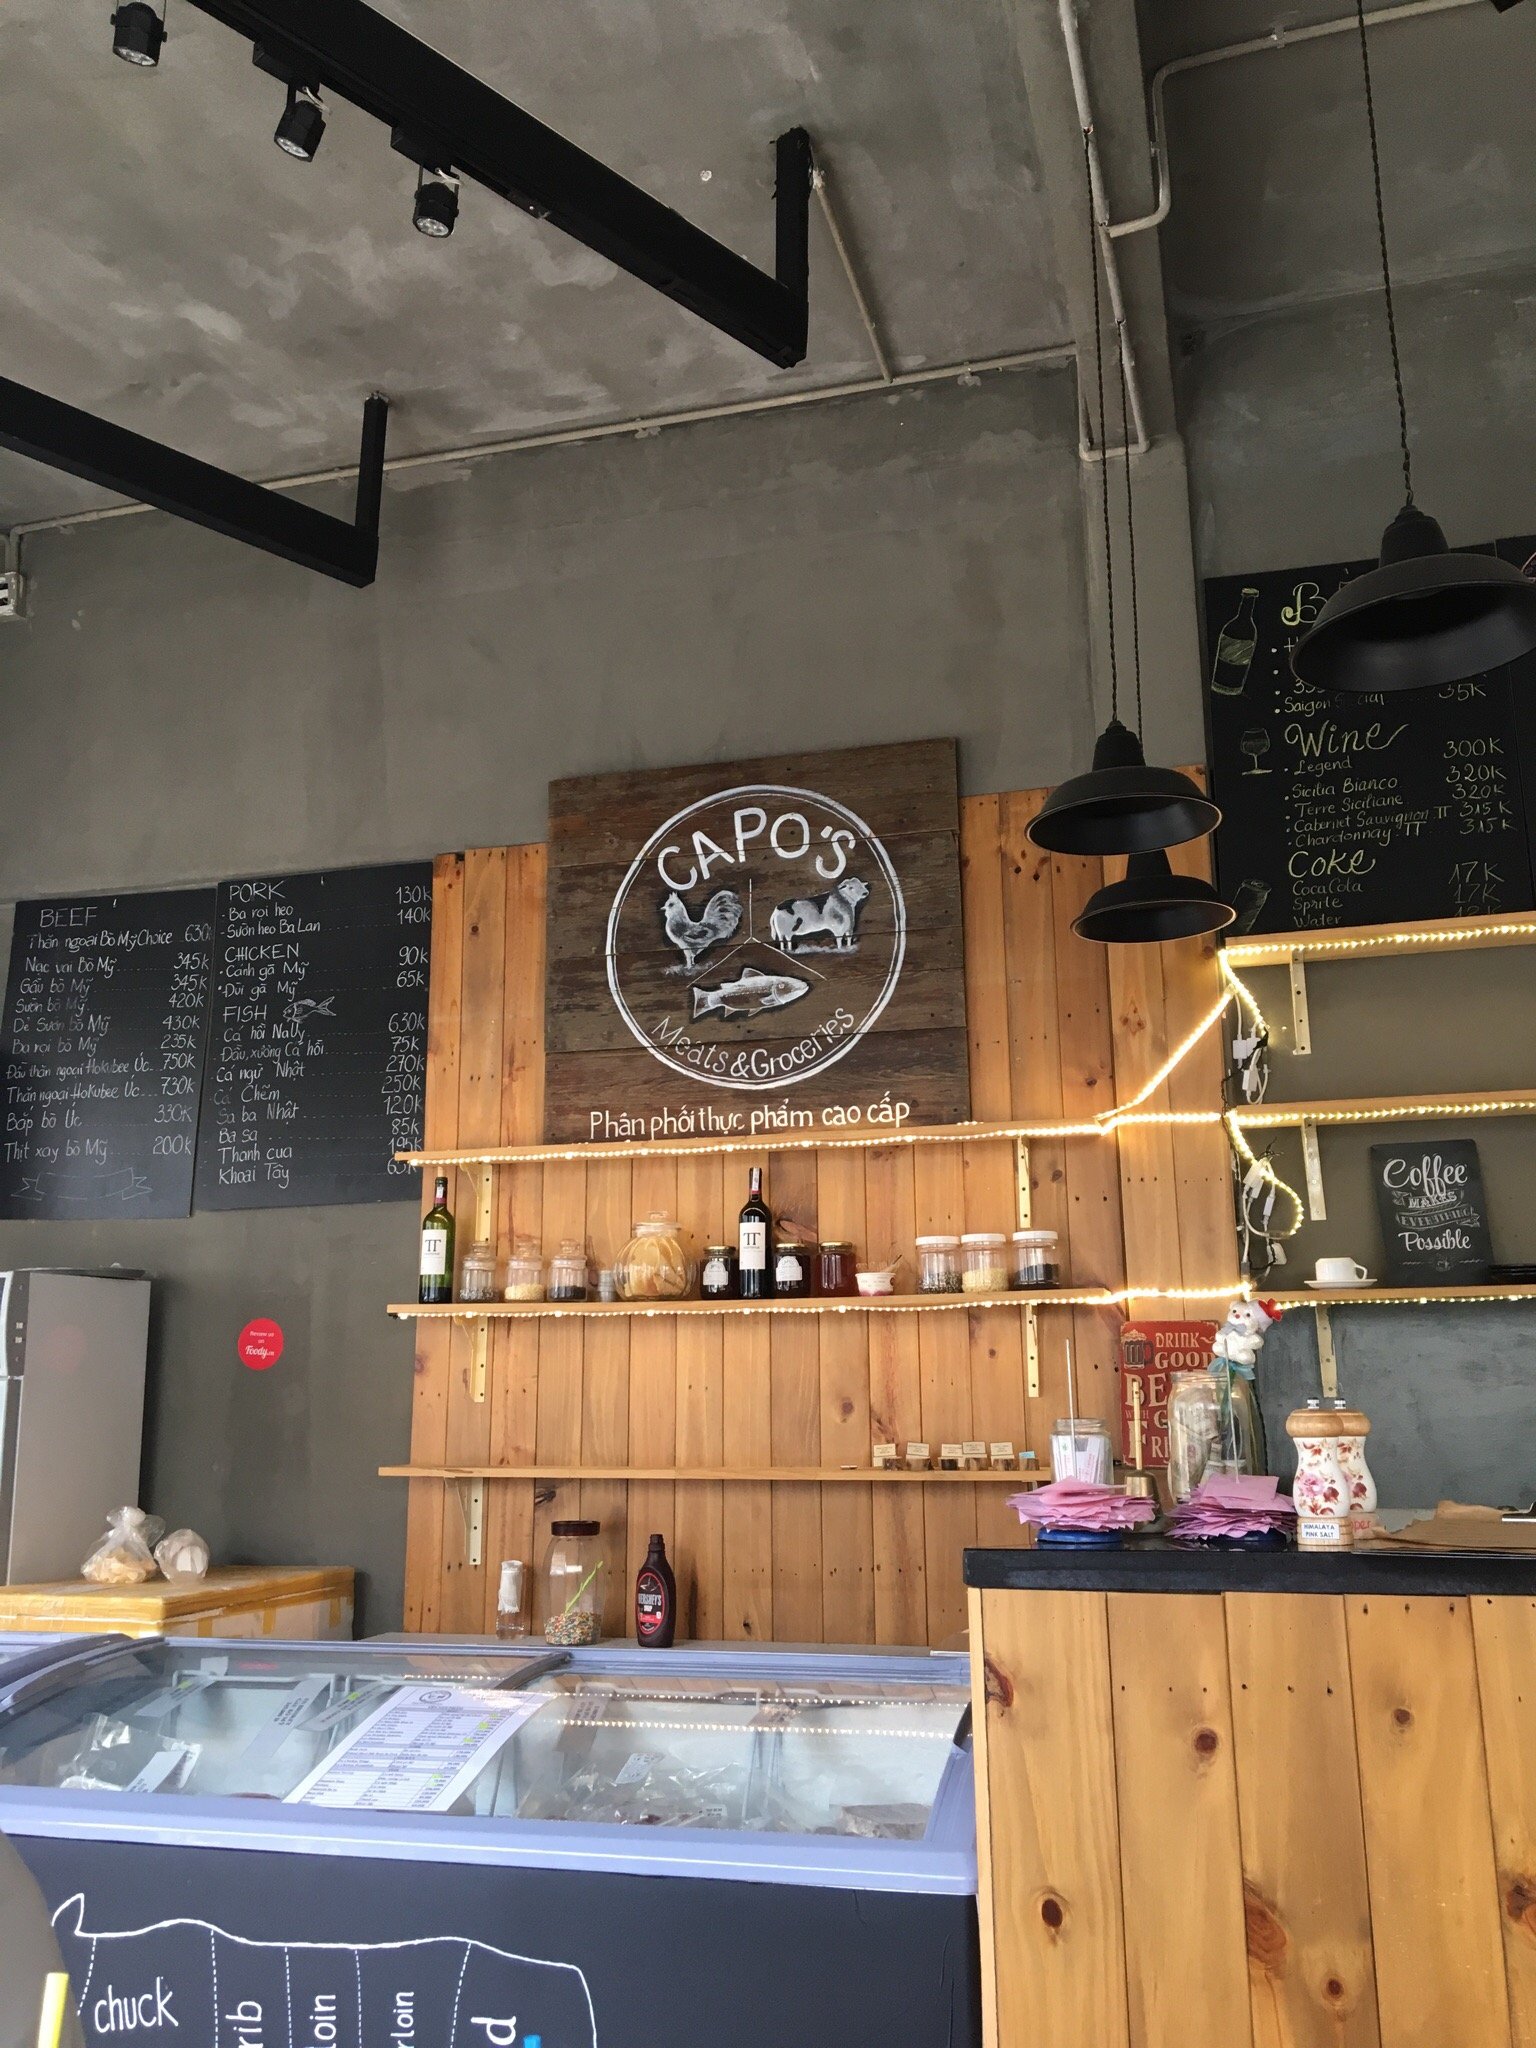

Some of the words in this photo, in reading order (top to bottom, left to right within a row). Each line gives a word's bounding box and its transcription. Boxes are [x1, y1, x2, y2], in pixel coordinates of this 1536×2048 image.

[1284, 696, 1331, 717] Saigon
[1284, 720, 1409, 757] Wine
[1294, 757, 1352, 778] Legend
[1343, 777, 1398, 794] Bianco
[1294, 801, 1336, 818] Terre
[1295, 828, 1392, 847] Chardonnay
[1288, 849, 1376, 878] Coke
[229, 880, 286, 903] PORK
[229, 906, 247, 922] Ba
[274, 902, 294, 917] heo
[1292, 896, 1343, 914] Sprite
[40, 907, 98, 928] BEEF
[257, 919, 276, 935] heo
[279, 919, 295, 934] Ba
[297, 918, 321, 933] Lan
[1294, 915, 1343, 928] Water
[118, 931, 137, 952] Mỹ
[137, 929, 173, 946] Choice
[224, 942, 300, 963] CHICKEN
[25, 957, 49, 976] Nạc
[56, 961, 72, 973] vai
[96, 956, 117, 979] Mỹ
[225, 963, 255, 978] Cánh
[283, 961, 310, 980] Mỹ
[71, 977, 93, 998] Mỹ
[277, 981, 298, 1001] Mỹ
[223, 1004, 268, 1024] FISH
[87, 1014, 111, 1037] Mỹ
[223, 1026, 244, 1043] Cá
[250, 1023, 266, 1040] hồi
[12, 1038, 30, 1054] Ba
[78, 1036, 99, 1057] Mỹ
[285, 1040, 304, 1057] Cá
[216, 1065, 235, 1083] Cá
[276, 1060, 306, 1082] Nhật
[7, 1105, 33, 1136] Bắp
[65, 1101, 83, 1129] Úc
[241, 1105, 257, 1121] ba
[266, 1100, 300, 1125] Nhật
[589, 1110, 646, 1140] Phân
[650, 1105, 696, 1140] phối
[699, 1106, 746, 1136] thực
[750, 1099, 813, 1135] phẩm
[821, 1105, 860, 1126] cao
[867, 1091, 910, 1128] cấp
[218, 1128, 236, 1144] Ba
[35, 1147, 59, 1164] xay
[86, 1138, 109, 1165] Mỹ
[218, 1145, 260, 1164] Thanh
[266, 1146, 293, 1160] cua
[218, 1165, 257, 1185] Khoai
[264, 1161, 290, 1189] Tây
[1383, 1154, 1468, 1198] Coffee
[1398, 1228, 1471, 1252] Possible
[1155, 1332, 1200, 1348] DRINK
[1303, 1523, 1335, 1531] HIMALAYA
[95, 1976, 179, 2033] chuck
[225, 2001, 263, 2048] rib
